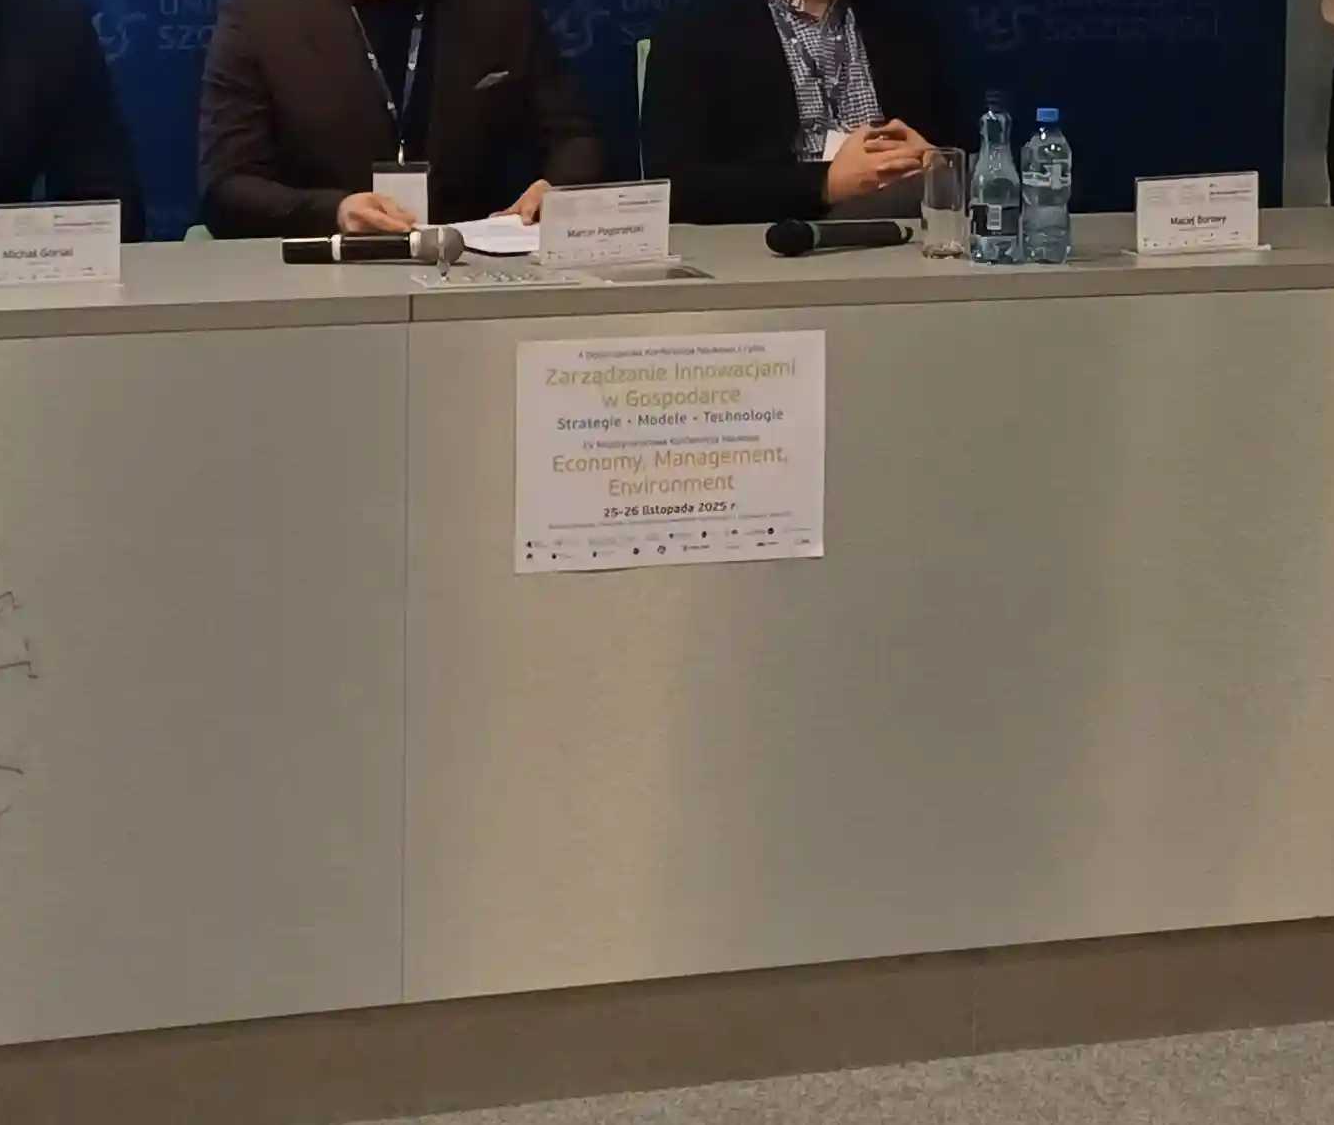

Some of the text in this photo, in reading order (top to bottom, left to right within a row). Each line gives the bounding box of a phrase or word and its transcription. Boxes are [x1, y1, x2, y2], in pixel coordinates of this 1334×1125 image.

[545, 358, 796, 387] Zarządzanie Innowacjami
[602, 387, 741, 410] w Gospodarce
[557, 408, 784, 431] Strategie Modele Technologie
[655, 445, 788, 469] Management,
[609, 474, 735, 497] Environment
[604, 506, 639, 518] 25-26
[642, 502, 694, 517] listopada
[698, 500, 727, 513] 2025
